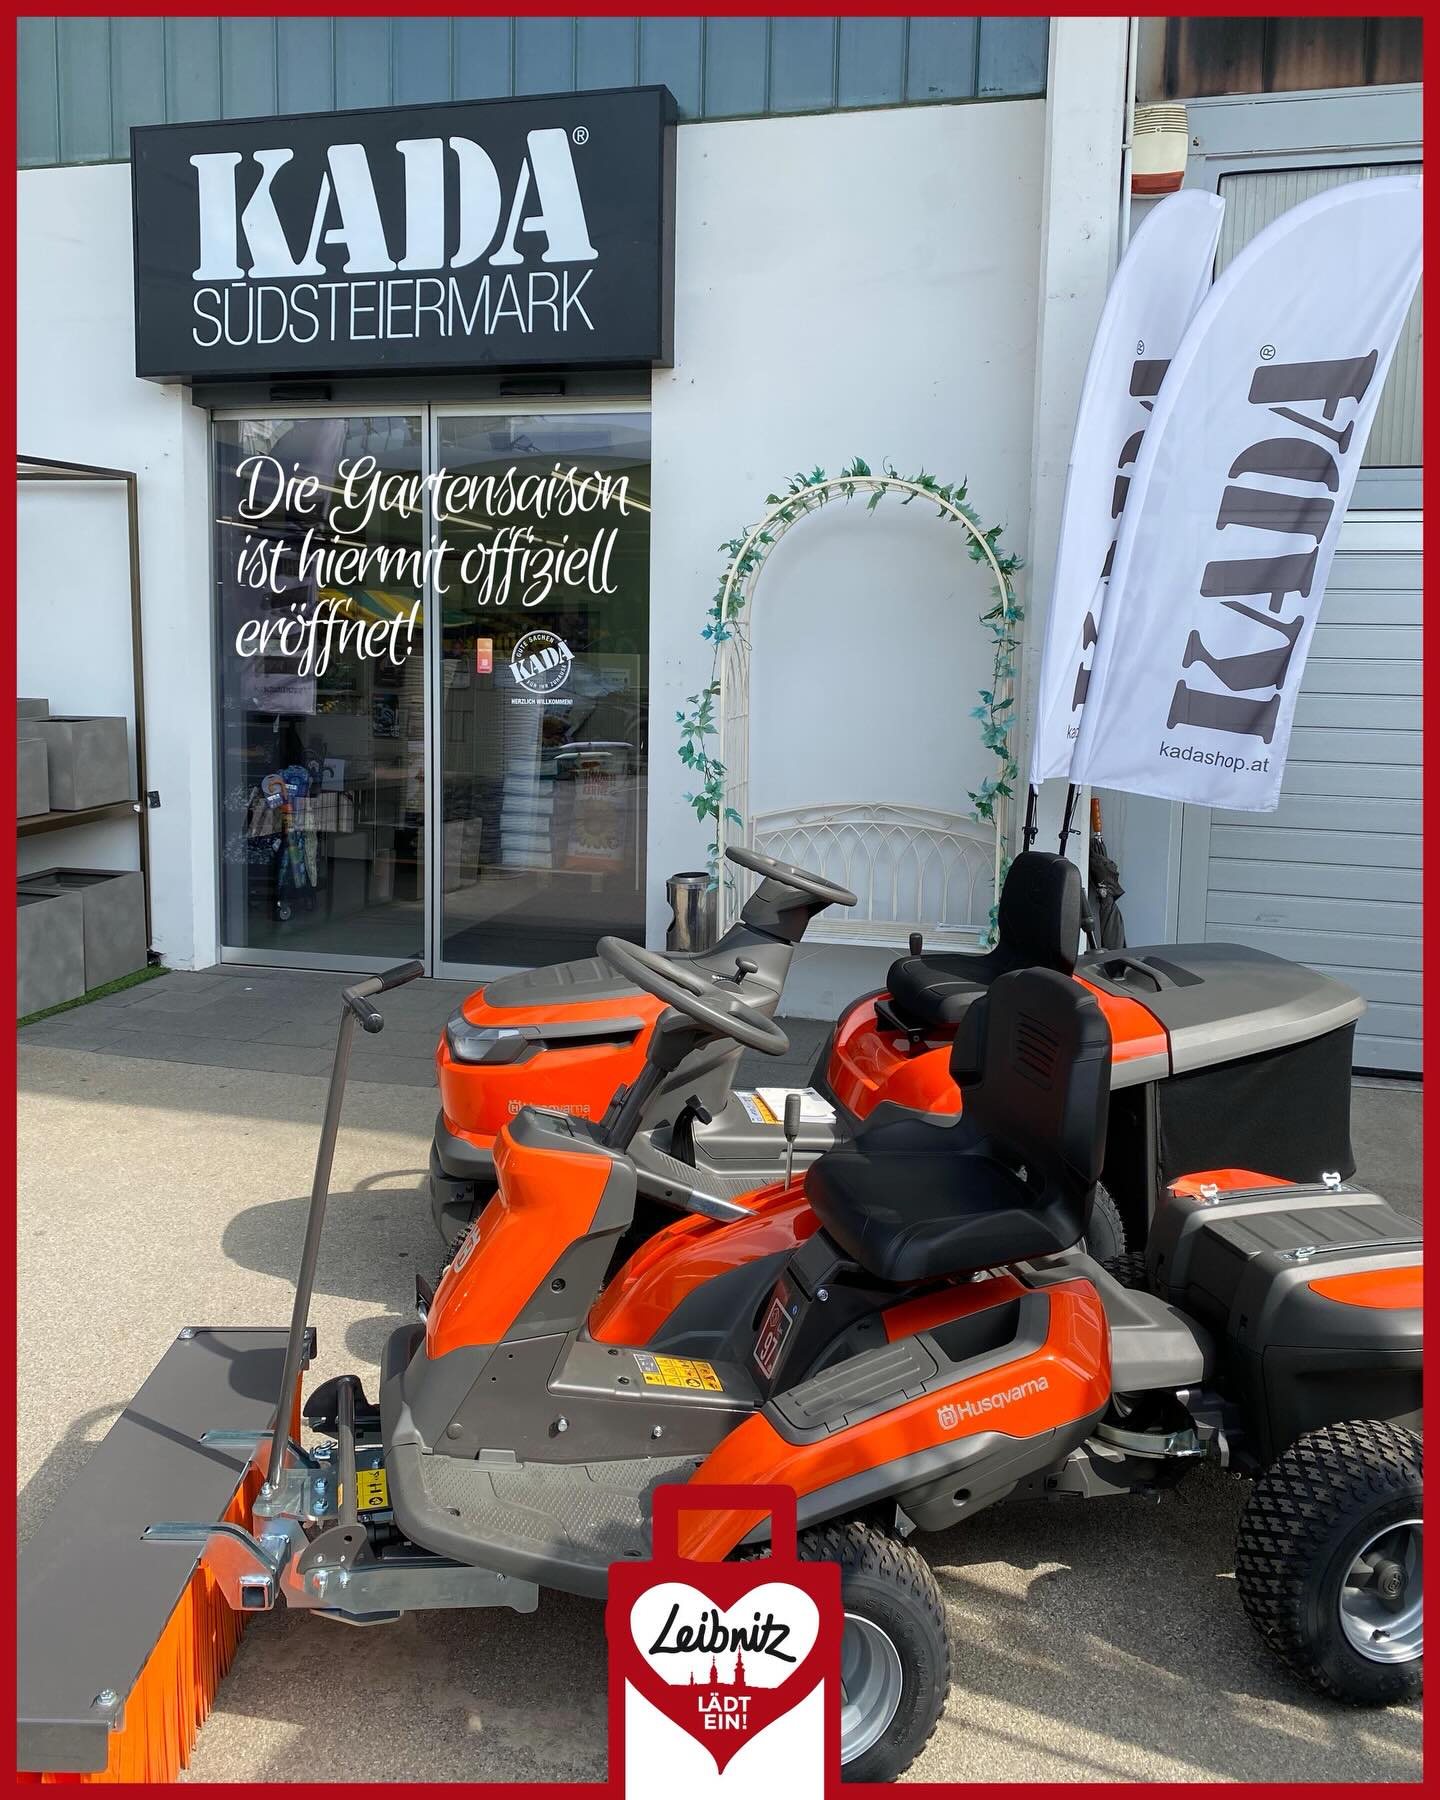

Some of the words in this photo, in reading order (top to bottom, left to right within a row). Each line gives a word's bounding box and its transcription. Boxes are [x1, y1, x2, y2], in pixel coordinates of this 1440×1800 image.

[192, 269, 595, 347] SÜDSTEIERMARK
[528, 634, 554, 644] SACHEN
[1158, 741, 1270, 774] kadashop.at
[956, 1376, 1049, 1421] Husqvarna
